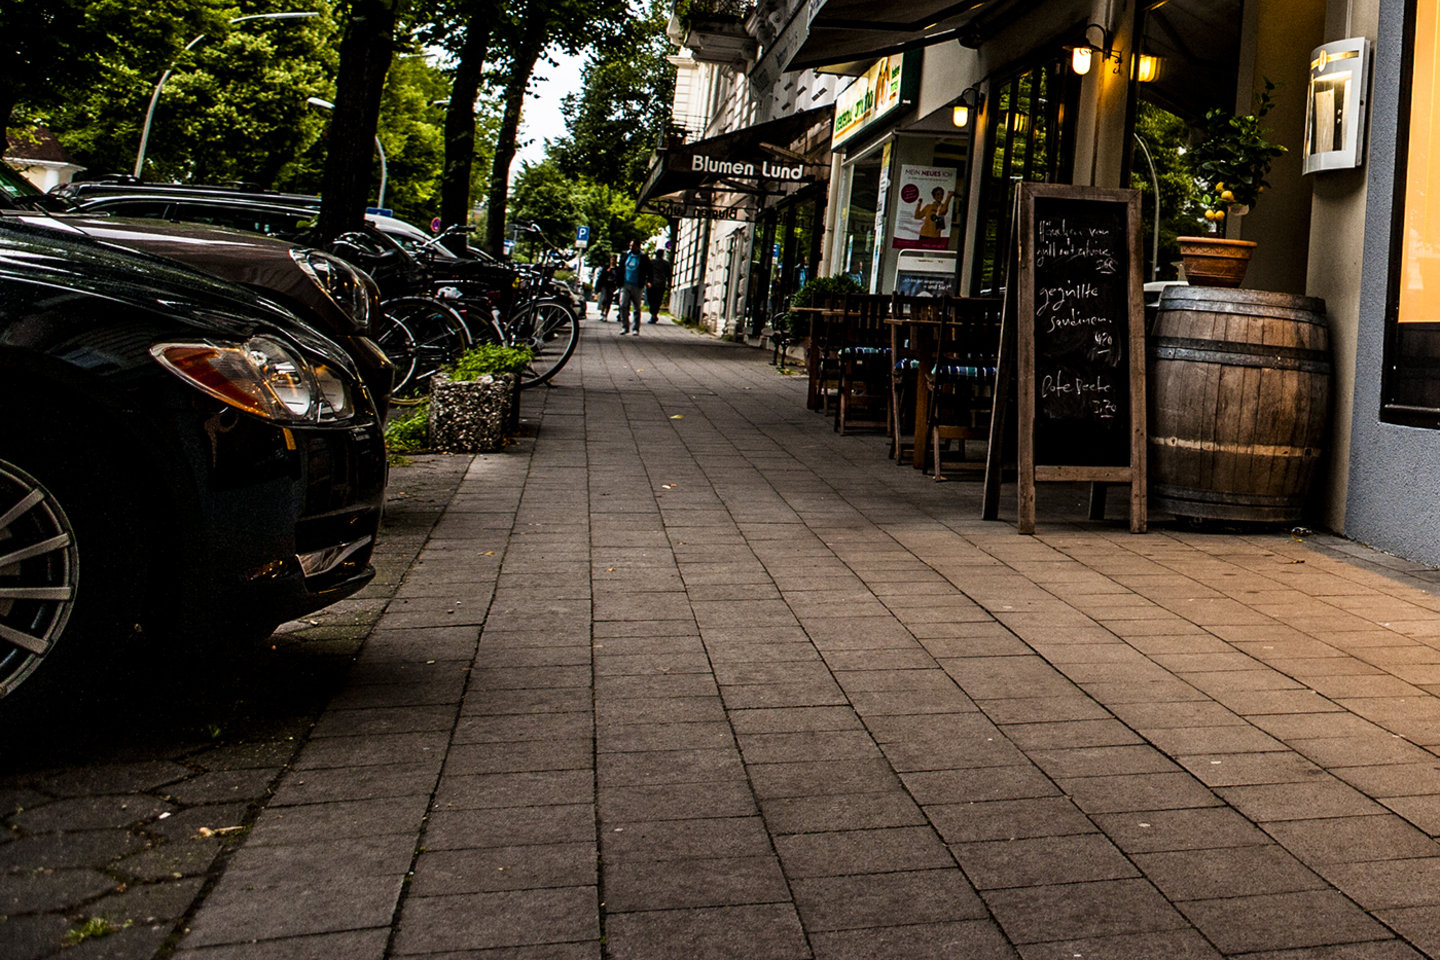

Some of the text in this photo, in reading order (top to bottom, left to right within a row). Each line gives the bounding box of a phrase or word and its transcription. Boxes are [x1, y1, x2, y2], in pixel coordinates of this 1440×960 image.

[691, 154, 804, 180] Blumen Lund
[578, 228, 587, 239] P
